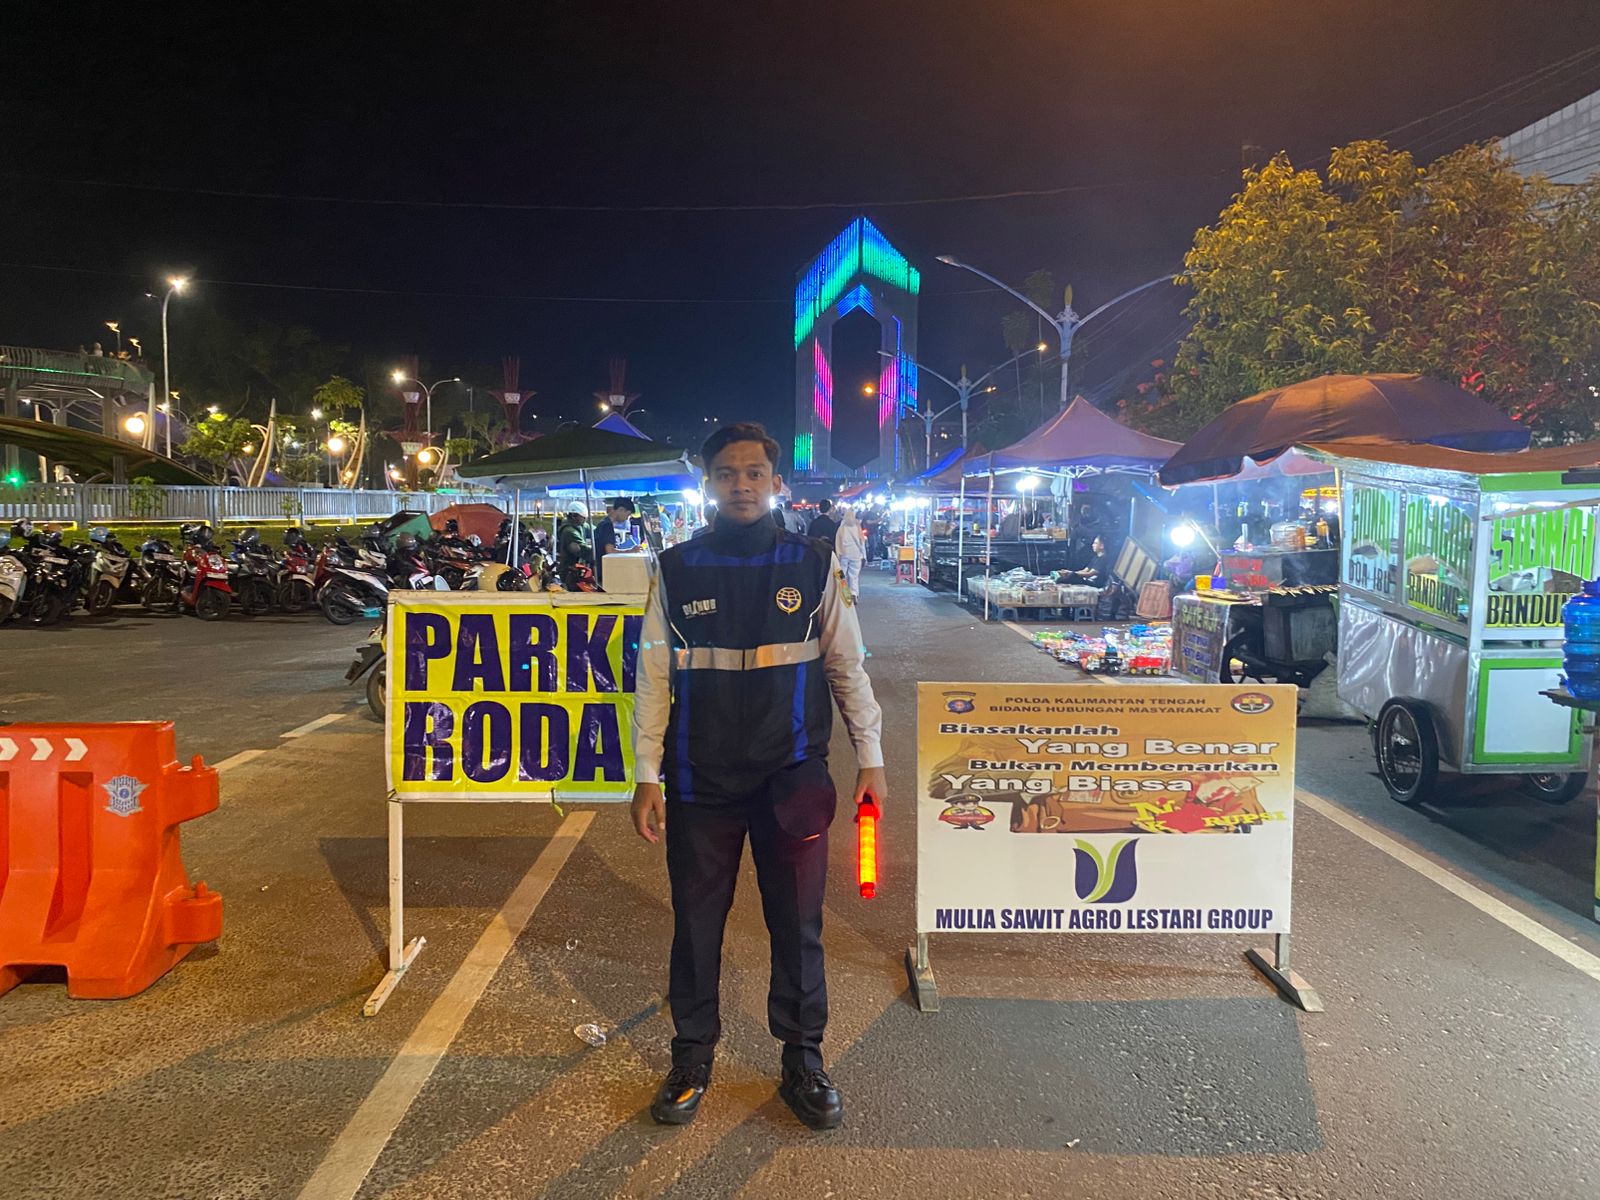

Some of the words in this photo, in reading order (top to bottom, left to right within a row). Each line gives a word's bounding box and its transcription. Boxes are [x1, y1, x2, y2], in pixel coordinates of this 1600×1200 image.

[1408, 573, 1460, 617] BANDUNG
[1486, 594, 1568, 626] BANDU
[404, 612, 645, 693] PARKI
[989, 705, 1041, 713] BIDANG
[1046, 705, 1125, 714] HUBUNGAN
[1129, 706, 1222, 714] MASYARAKAT
[1005, 696, 1050, 705] POLDA
[1054, 697, 1146, 706] KALIMANTAN
[1150, 697, 1206, 705] TENGAH
[939, 723, 1118, 735] Biasakanlah
[403, 701, 626, 783] RODA
[1017, 738, 1129, 758] Yang
[1144, 739, 1279, 755] Benar
[970, 760, 1062, 771] Bukan
[1071, 760, 1278, 772] Membenarkan
[943, 774, 1053, 793] Yang
[1067, 775, 1192, 792] Biasa
[935, 909, 996, 930] MULIA
[1000, 909, 1064, 930] SAWIT
[1068, 909, 1122, 930] AGRO
[1127, 909, 1201, 930] LESTARI
[1207, 909, 1273, 930] GROUP
